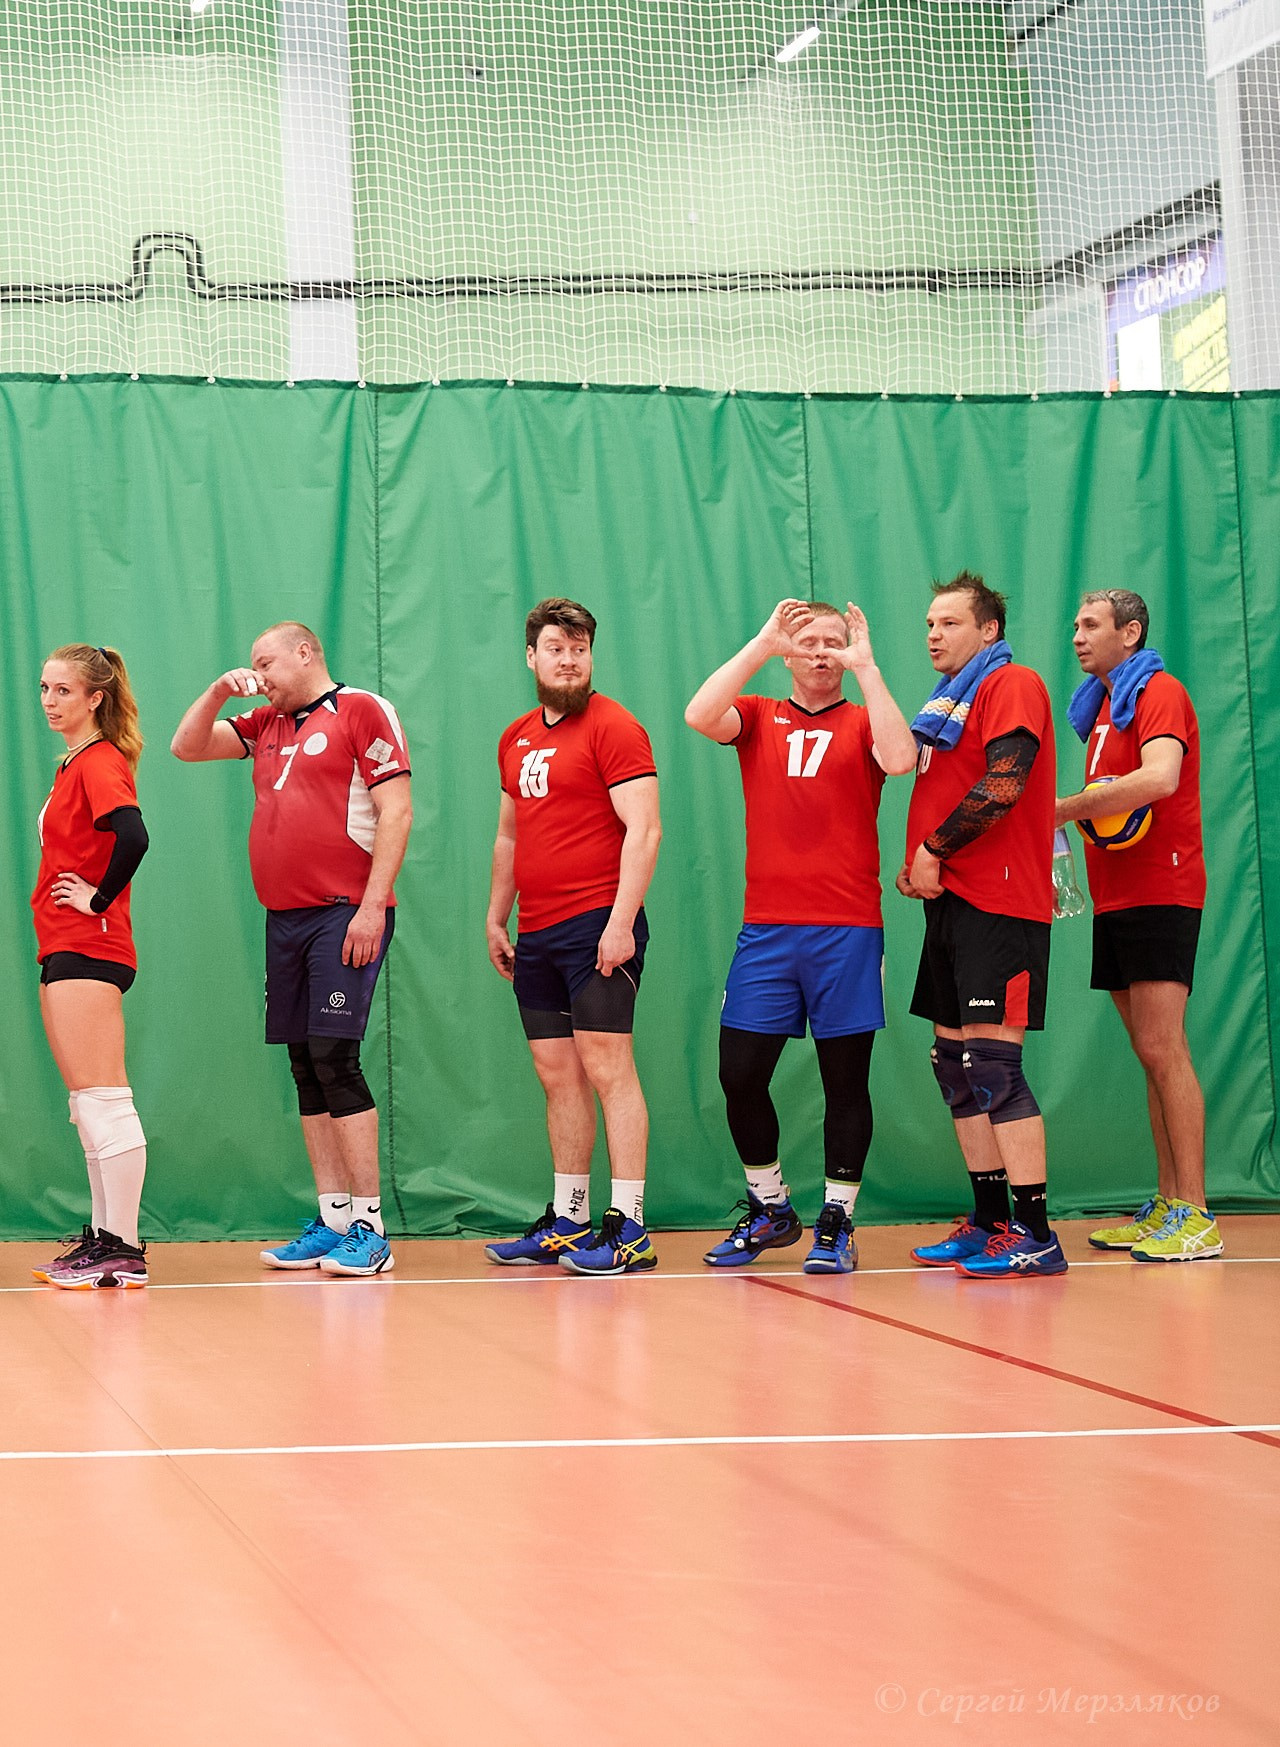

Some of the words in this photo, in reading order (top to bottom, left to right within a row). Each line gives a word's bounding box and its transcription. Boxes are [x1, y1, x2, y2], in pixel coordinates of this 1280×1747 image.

[1133, 256, 1206, 313] СПОНСОР
[273, 743, 300, 790] 7
[518, 747, 558, 798] 15
[786, 729, 833, 777] 17
[1089, 724, 1110, 776] 7
